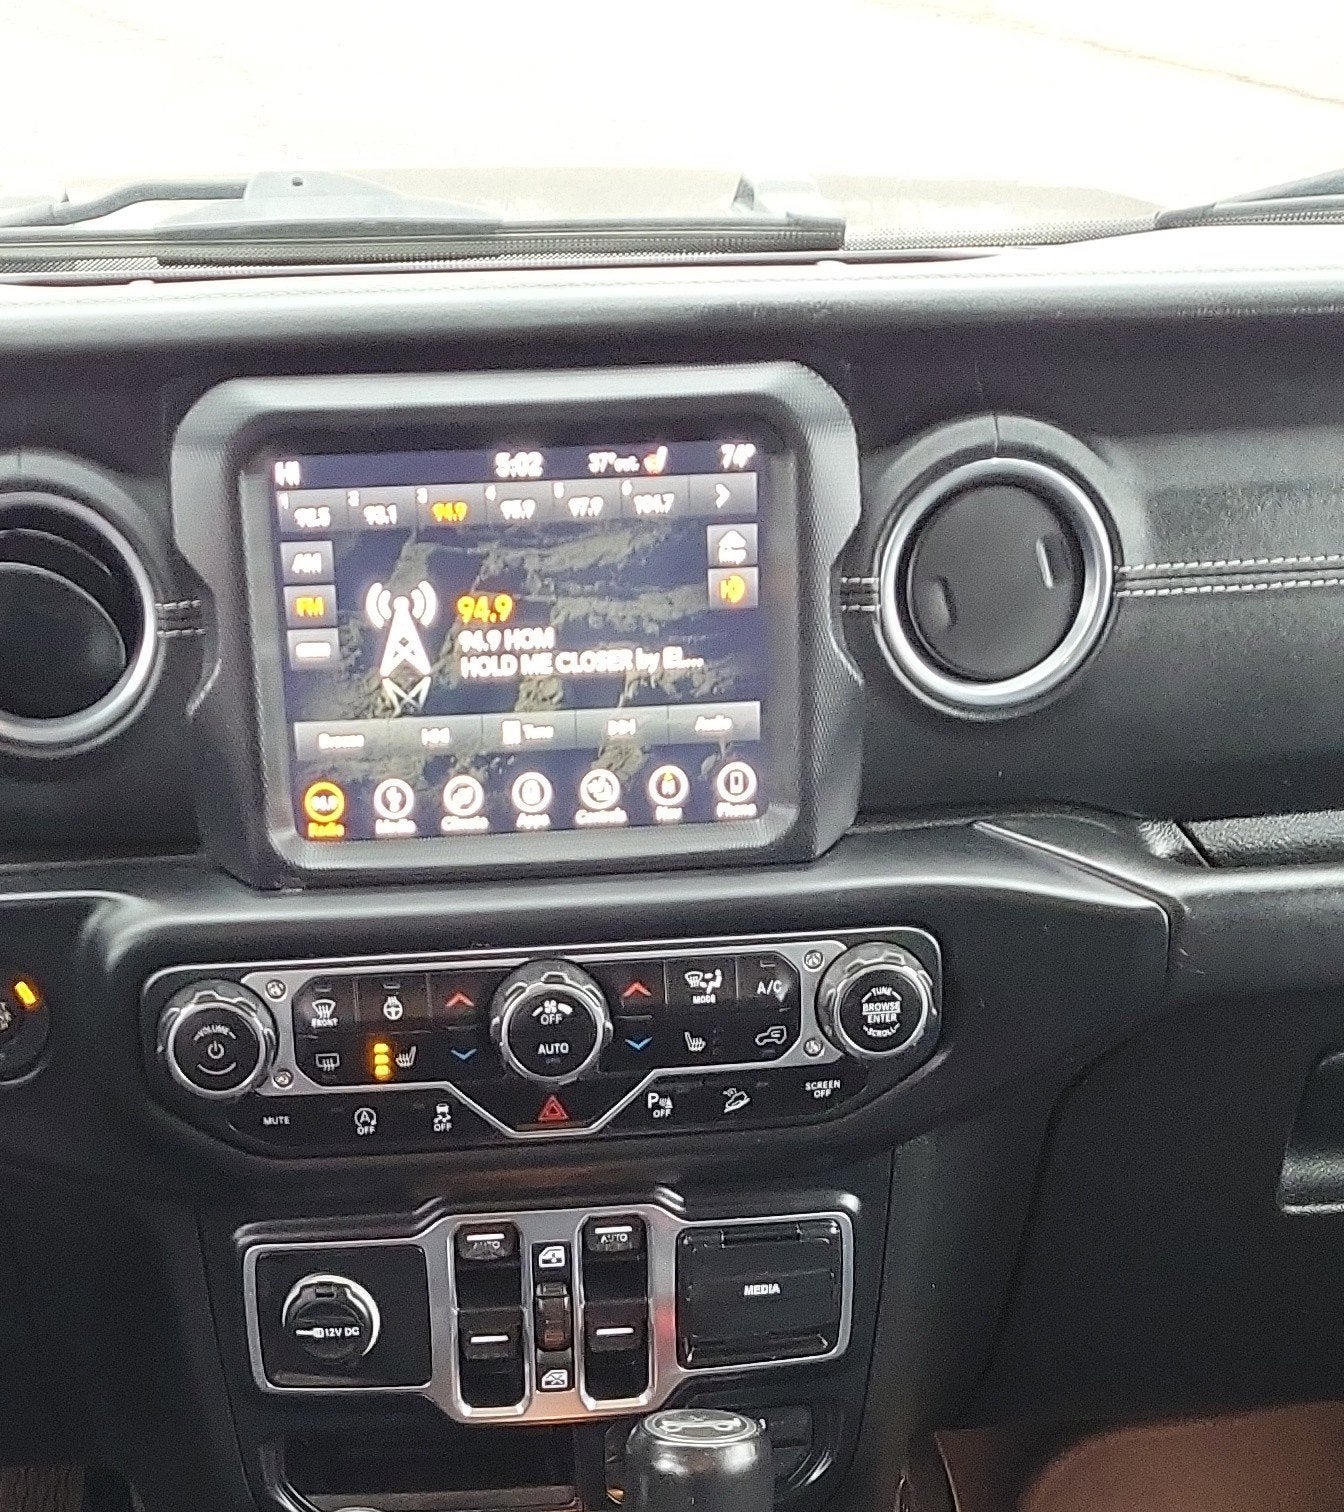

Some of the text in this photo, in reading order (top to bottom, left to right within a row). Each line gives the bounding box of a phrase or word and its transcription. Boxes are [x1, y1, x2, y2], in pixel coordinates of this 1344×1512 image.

[457, 594, 514, 624] 94.9
[461, 654, 518, 678] HOLD
[521, 652, 554, 676] ME
[556, 649, 633, 675] CLOSER
[636, 648, 660, 674] by
[756, 979, 783, 996] A/C
[871, 986, 893, 997] TUNE
[862, 1001, 901, 1013] BROWSE
[311, 1018, 338, 1029] FRONT
[540, 1013, 563, 1026] OFF
[867, 1013, 897, 1024] ENTER
[198, 1024, 231, 1037] VOLUME
[867, 1026, 897, 1038] SCROLL
[537, 1042, 570, 1056] AUTO
[805, 1080, 841, 1091] SCREEN
[814, 1089, 832, 1099] OFF
[652, 1108, 672, 1119] OFF
[263, 1114, 291, 1126] MUTE
[356, 1125, 377, 1136] OFF
[433, 1121, 453, 1133] OFF
[600, 1233, 628, 1244] AUTO
[744, 1282, 781, 1297] MEDIA
[325, 1326, 360, 1337] 12V DC
